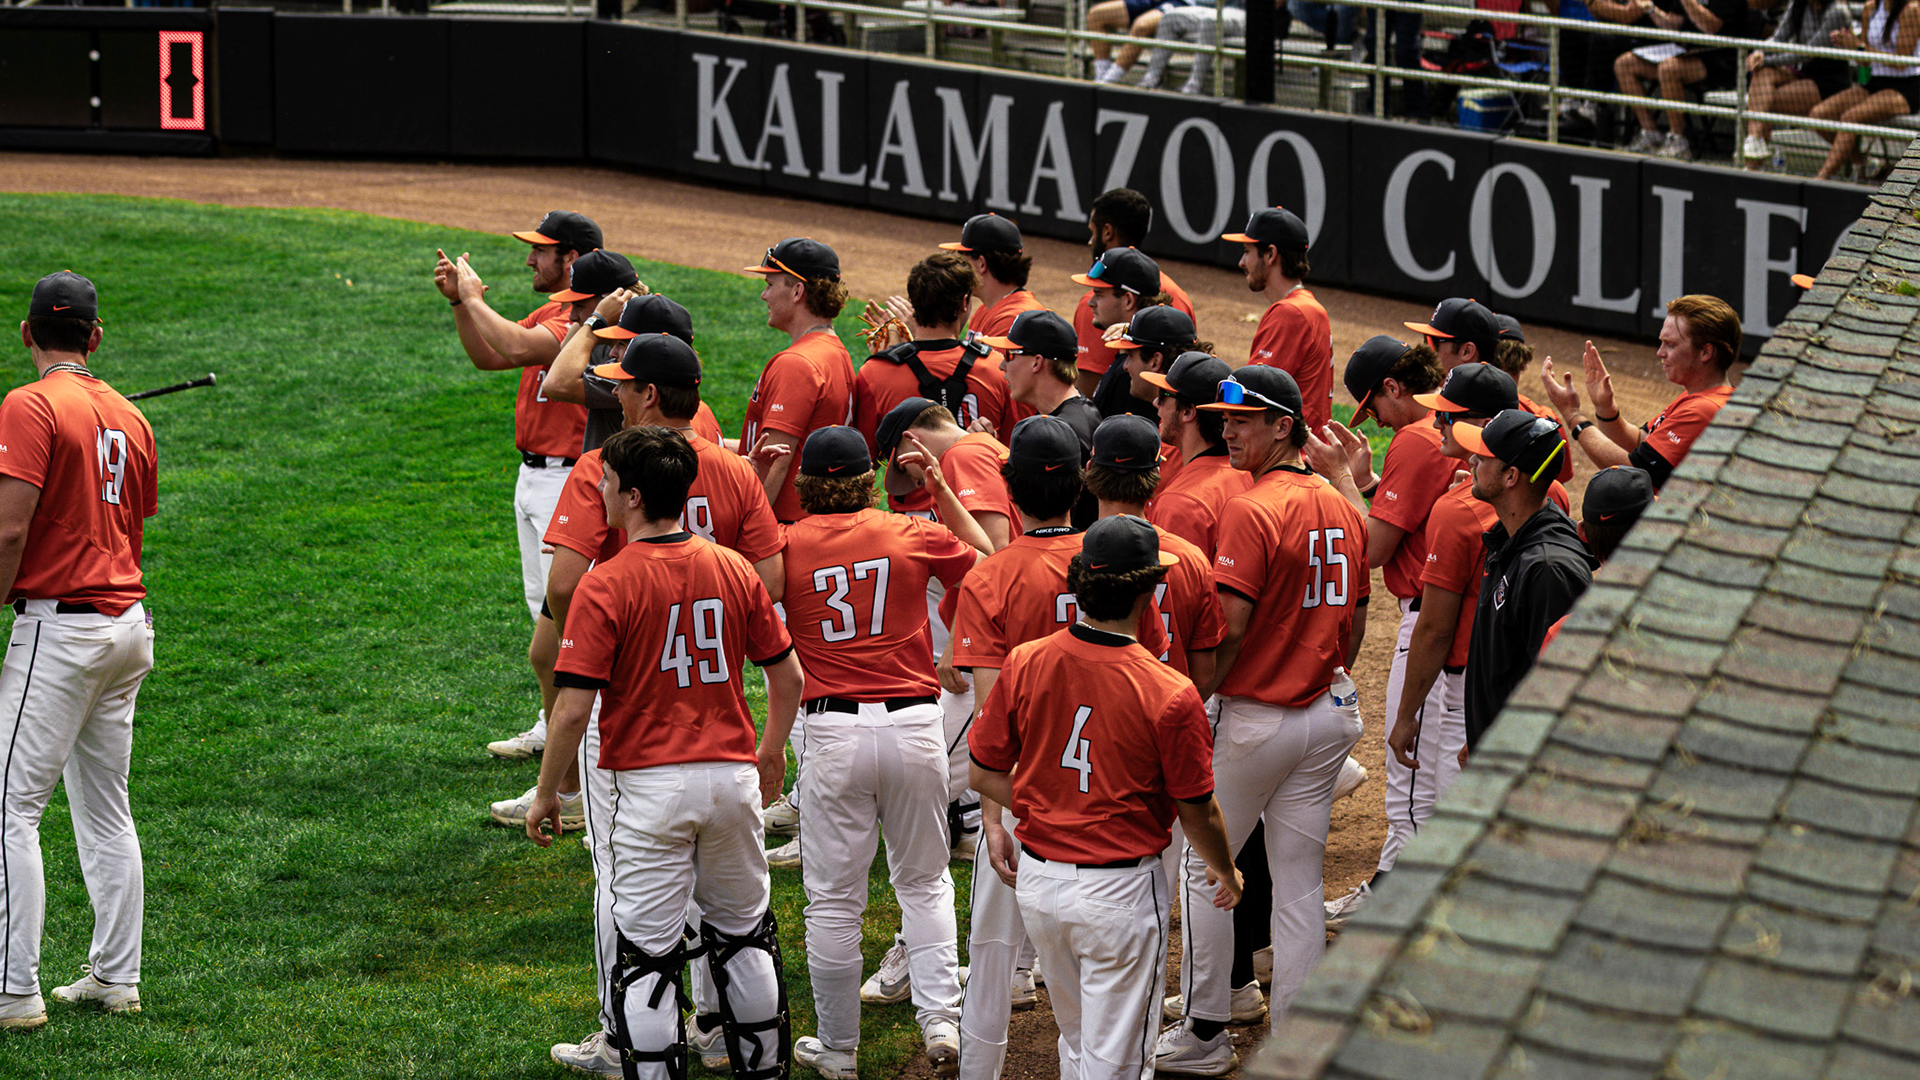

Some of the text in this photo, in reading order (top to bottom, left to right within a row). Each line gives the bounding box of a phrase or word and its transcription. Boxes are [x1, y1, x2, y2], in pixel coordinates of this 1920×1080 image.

[159, 31, 205, 130] 0
[692, 53, 1326, 251] KALAMAZOO
[1035, 526, 1070, 536] NIKE PRO
[1302, 528, 1348, 609] 55
[660, 598, 730, 689] 49
[813, 557, 891, 642] 37
[1060, 705, 1092, 794] 4
